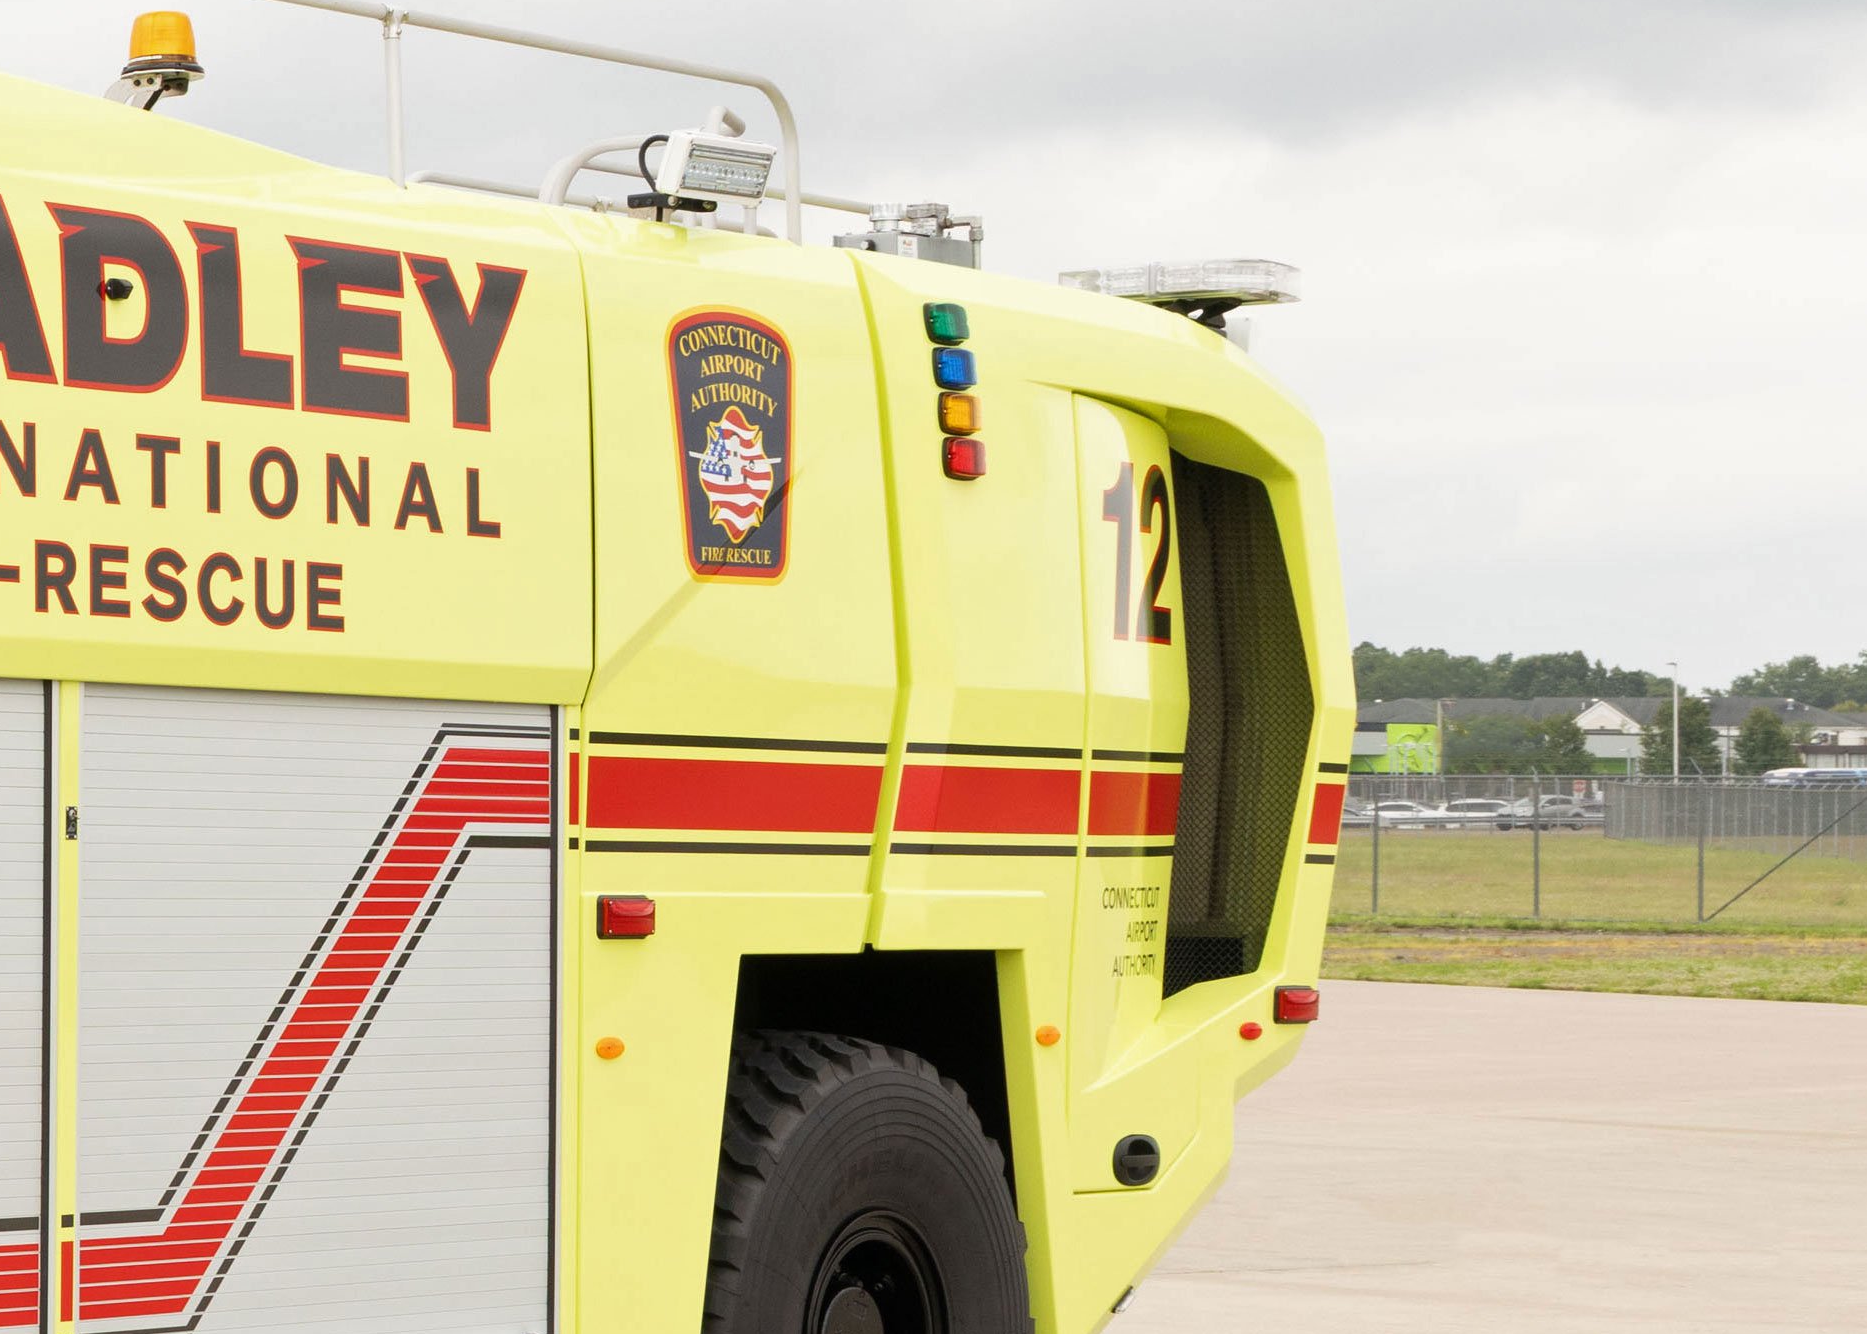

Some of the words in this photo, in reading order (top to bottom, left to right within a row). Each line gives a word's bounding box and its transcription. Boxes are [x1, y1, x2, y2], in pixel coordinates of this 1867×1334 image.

[679, 325, 781, 366] CONNECTICUT
[700, 355, 765, 382] AIRPORT
[691, 383, 778, 418] AUTHORITY
[701, 547, 726, 562] FIRE
[727, 547, 772, 565] RESCUE
[1102, 461, 1172, 645] 12
[1102, 886, 1160, 909] CONNECTICUT
[1125, 920, 1158, 942] AIRPORT
[1112, 953, 1155, 977] AUTHORITY
